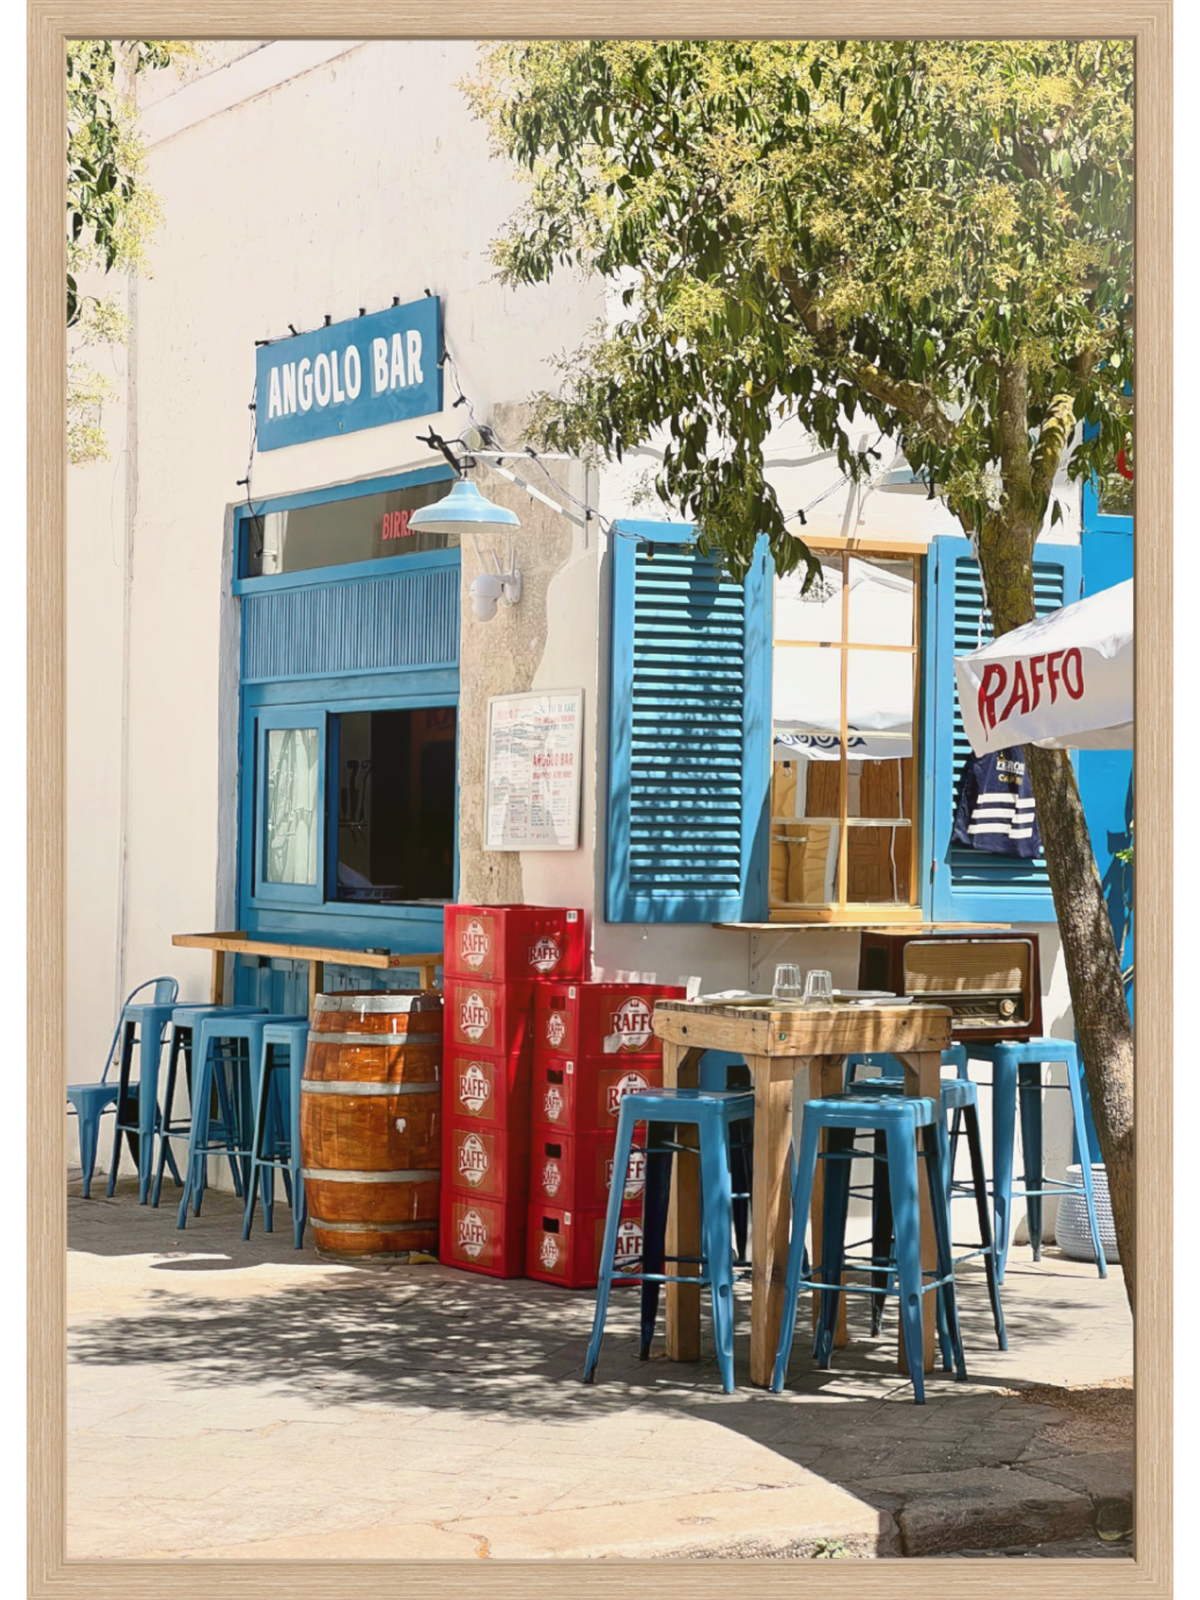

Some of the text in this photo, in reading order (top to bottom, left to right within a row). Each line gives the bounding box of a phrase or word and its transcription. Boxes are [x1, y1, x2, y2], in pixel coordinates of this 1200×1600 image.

[267, 329, 424, 419] ANGOLO BAR
[978, 647, 1084, 742] RAFFO
[461, 932, 489, 954] RAFFO
[529, 947, 561, 963] RAFFO
[461, 1007, 489, 1030] RAFFO
[460, 1076, 489, 1099] RAFFO
[459, 1147, 488, 1170] RAFFO
[459, 1220, 487, 1243] RAFFO
